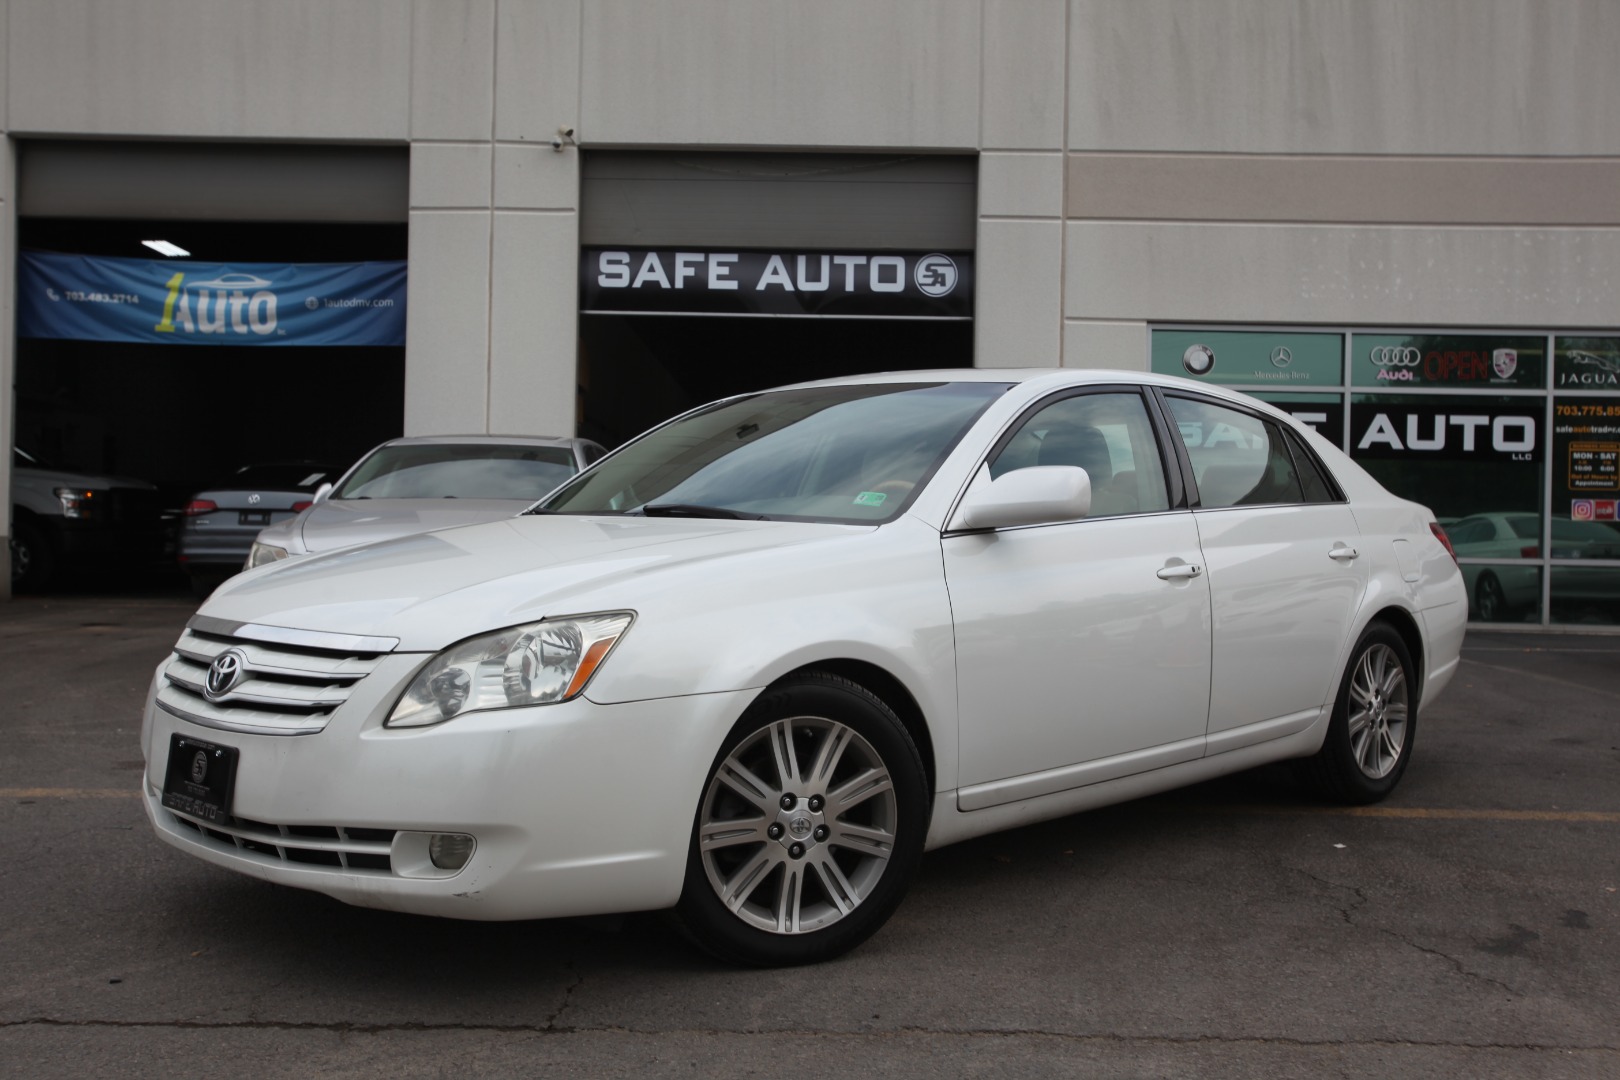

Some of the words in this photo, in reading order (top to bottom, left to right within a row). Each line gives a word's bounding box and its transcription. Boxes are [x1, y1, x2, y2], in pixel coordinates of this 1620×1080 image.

[597, 251, 739, 290] SAFE
[756, 254, 906, 292] AUTO
[324, 298, 394, 308] 1autodmv.com
[1377, 369, 1414, 381] Audi
[1424, 350, 1489, 381] OPEN
[1357, 413, 1536, 452] AUTO
[1512, 453, 1532, 461] LLC
